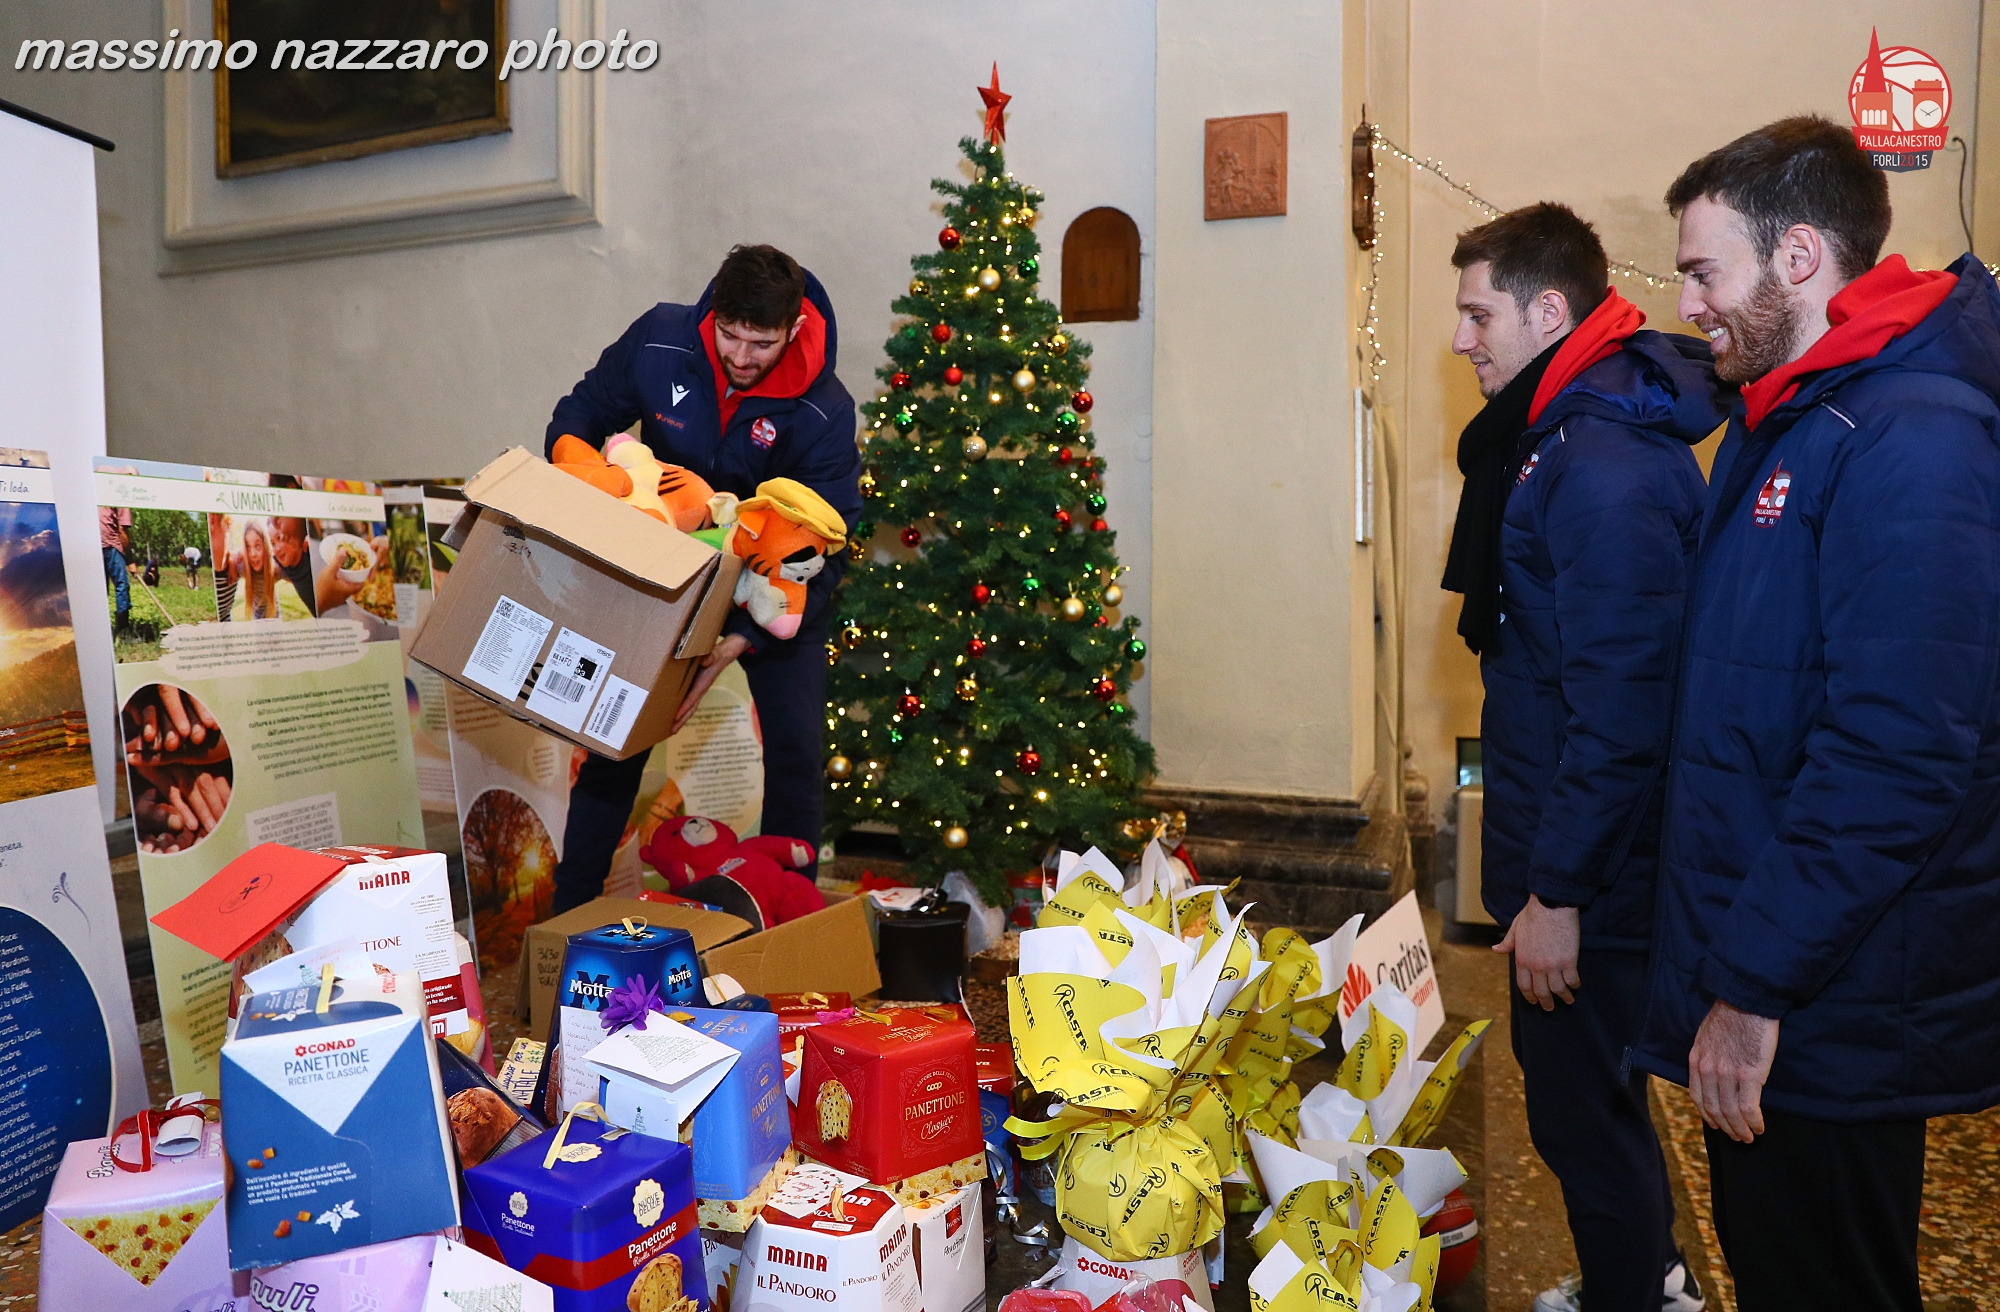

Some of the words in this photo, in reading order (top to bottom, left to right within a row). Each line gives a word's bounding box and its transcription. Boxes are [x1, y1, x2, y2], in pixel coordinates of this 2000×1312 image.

[9, 481, 29, 493] loda
[231, 490, 285, 512] UMANITÀ
[360, 936, 402, 952] TTONE
[1098, 931, 1134, 948] ASTA
[1377, 939, 1428, 992] Caritas
[667, 969, 692, 986] Motta
[1018, 976, 1035, 1029] CASTA
[1062, 1000, 1089, 1051] CASTA
[308, 1038, 355, 1054] CONAD
[833, 1046, 845, 1056] coop
[284, 1049, 369, 1075] PANETTONE
[288, 1074, 323, 1087] RICETTA
[326, 1065, 368, 1080] CLASSICA
[926, 1081, 942, 1092] coop
[1180, 1072, 1210, 1081] ASTA
[751, 1080, 781, 1123] PANETTONE
[905, 1091, 965, 1121] PANETTONE
[246, 1174, 281, 1184] Dall'incontro
[290, 1167, 319, 1177] ingredienti
[327, 1162, 346, 1171] qualità
[270, 1178, 298, 1187] Panettone
[299, 1172, 332, 1182] Tradizionale
[256, 1188, 280, 1197] prodotto
[281, 1182, 310, 1193] profumato
[638, 1192, 659, 1209] NUOVE
[638, 1198, 661, 1217] DELIZIE
[1122, 1180, 1155, 1226] CASTA
[1370, 1183, 1394, 1238] CASTA
[501, 1212, 535, 1232] Panettone
[628, 1221, 677, 1259] Panettone
[650, 1235, 675, 1257] Tradizionale
[879, 1223, 907, 1263] MAINA
[767, 1245, 828, 1272] MAINA
[886, 1245, 911, 1278] PANDORO
[842, 1278, 848, 1286] IL
[848, 1274, 878, 1286] PANDORO
[1090, 1261, 1133, 1281] CONA
[251, 1277, 320, 1312] auli
[757, 1275, 766, 1289] IL
[768, 1274, 837, 1303] PANDORO
